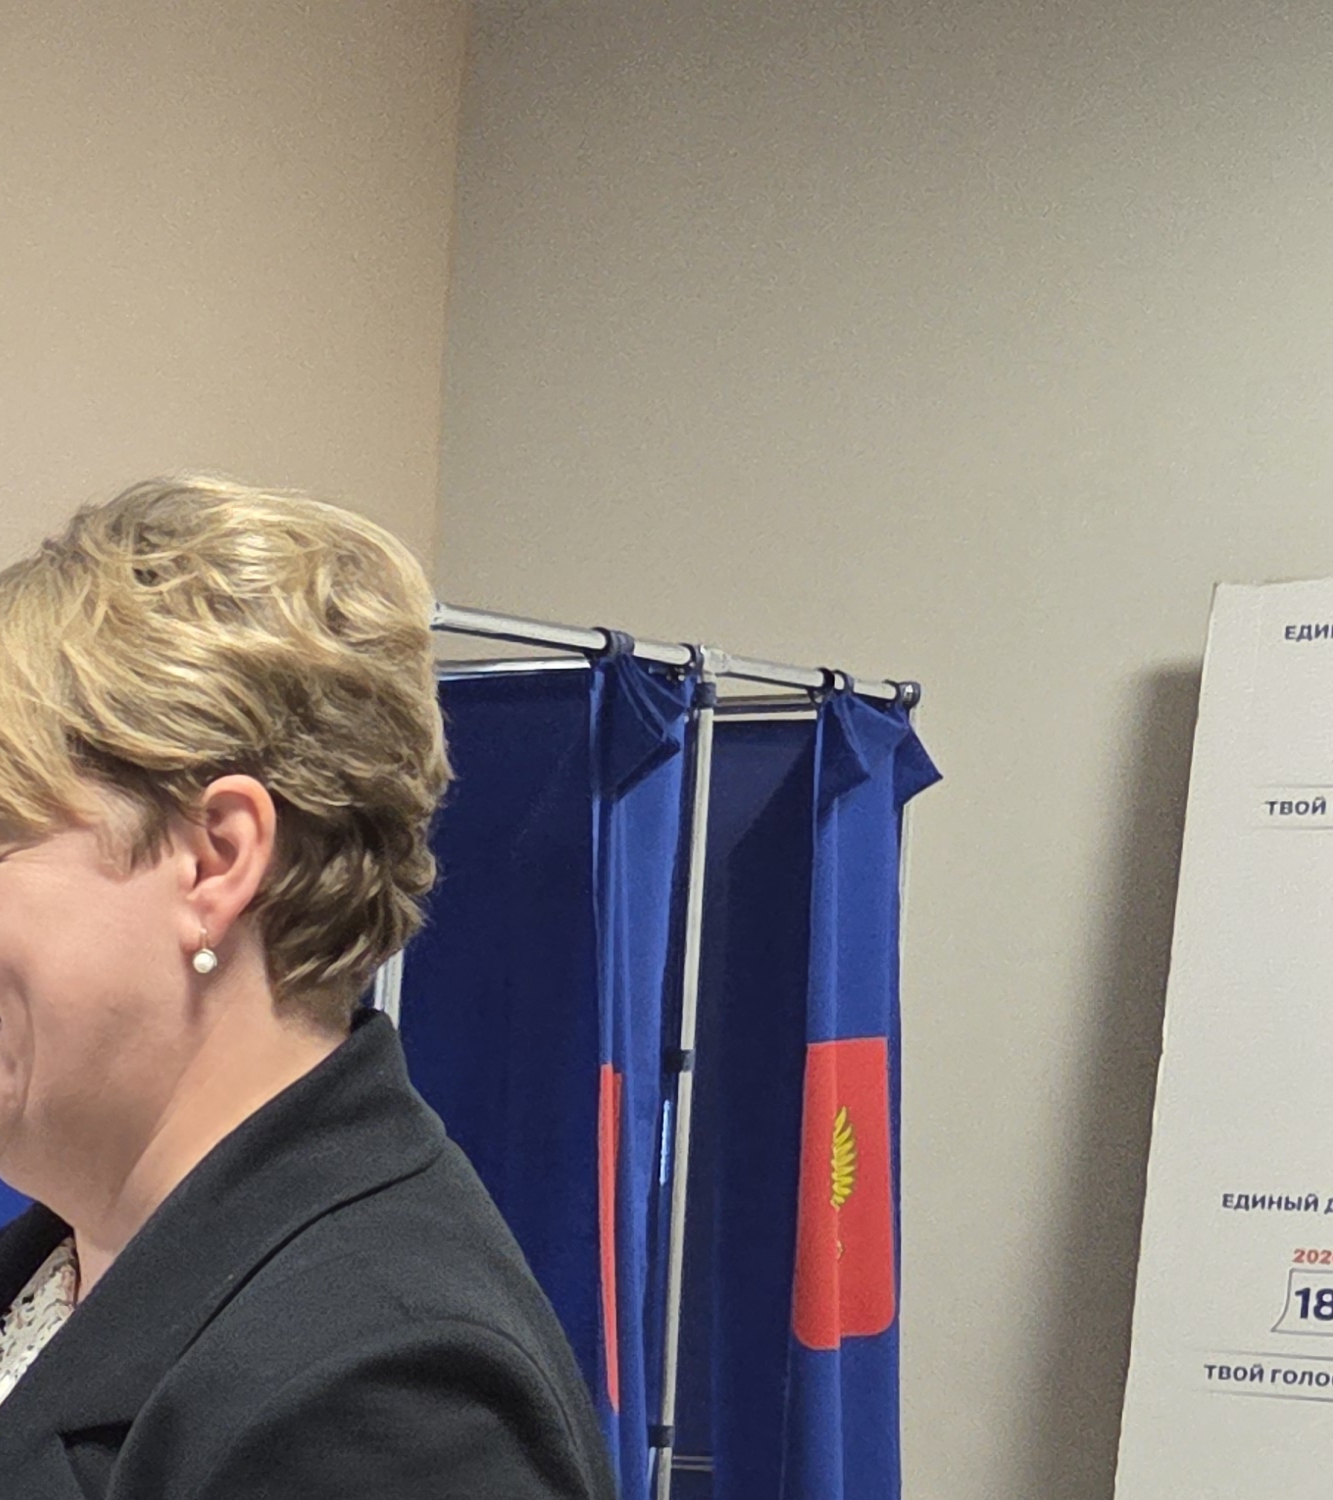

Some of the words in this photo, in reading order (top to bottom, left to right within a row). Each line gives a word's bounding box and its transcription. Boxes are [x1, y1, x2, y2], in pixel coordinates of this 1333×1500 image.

[1285, 623, 1333, 642] ЕДИ
[1265, 796, 1327, 816] ТВОЙ
[1222, 1193, 1319, 1213] ЕДИНЫЙ
[1292, 1248, 1333, 1265] 202
[1294, 1287, 1333, 1321] 18
[1204, 1363, 1265, 1384] ТВОЙ
[1270, 1368, 1333, 1388] ГОЛО
